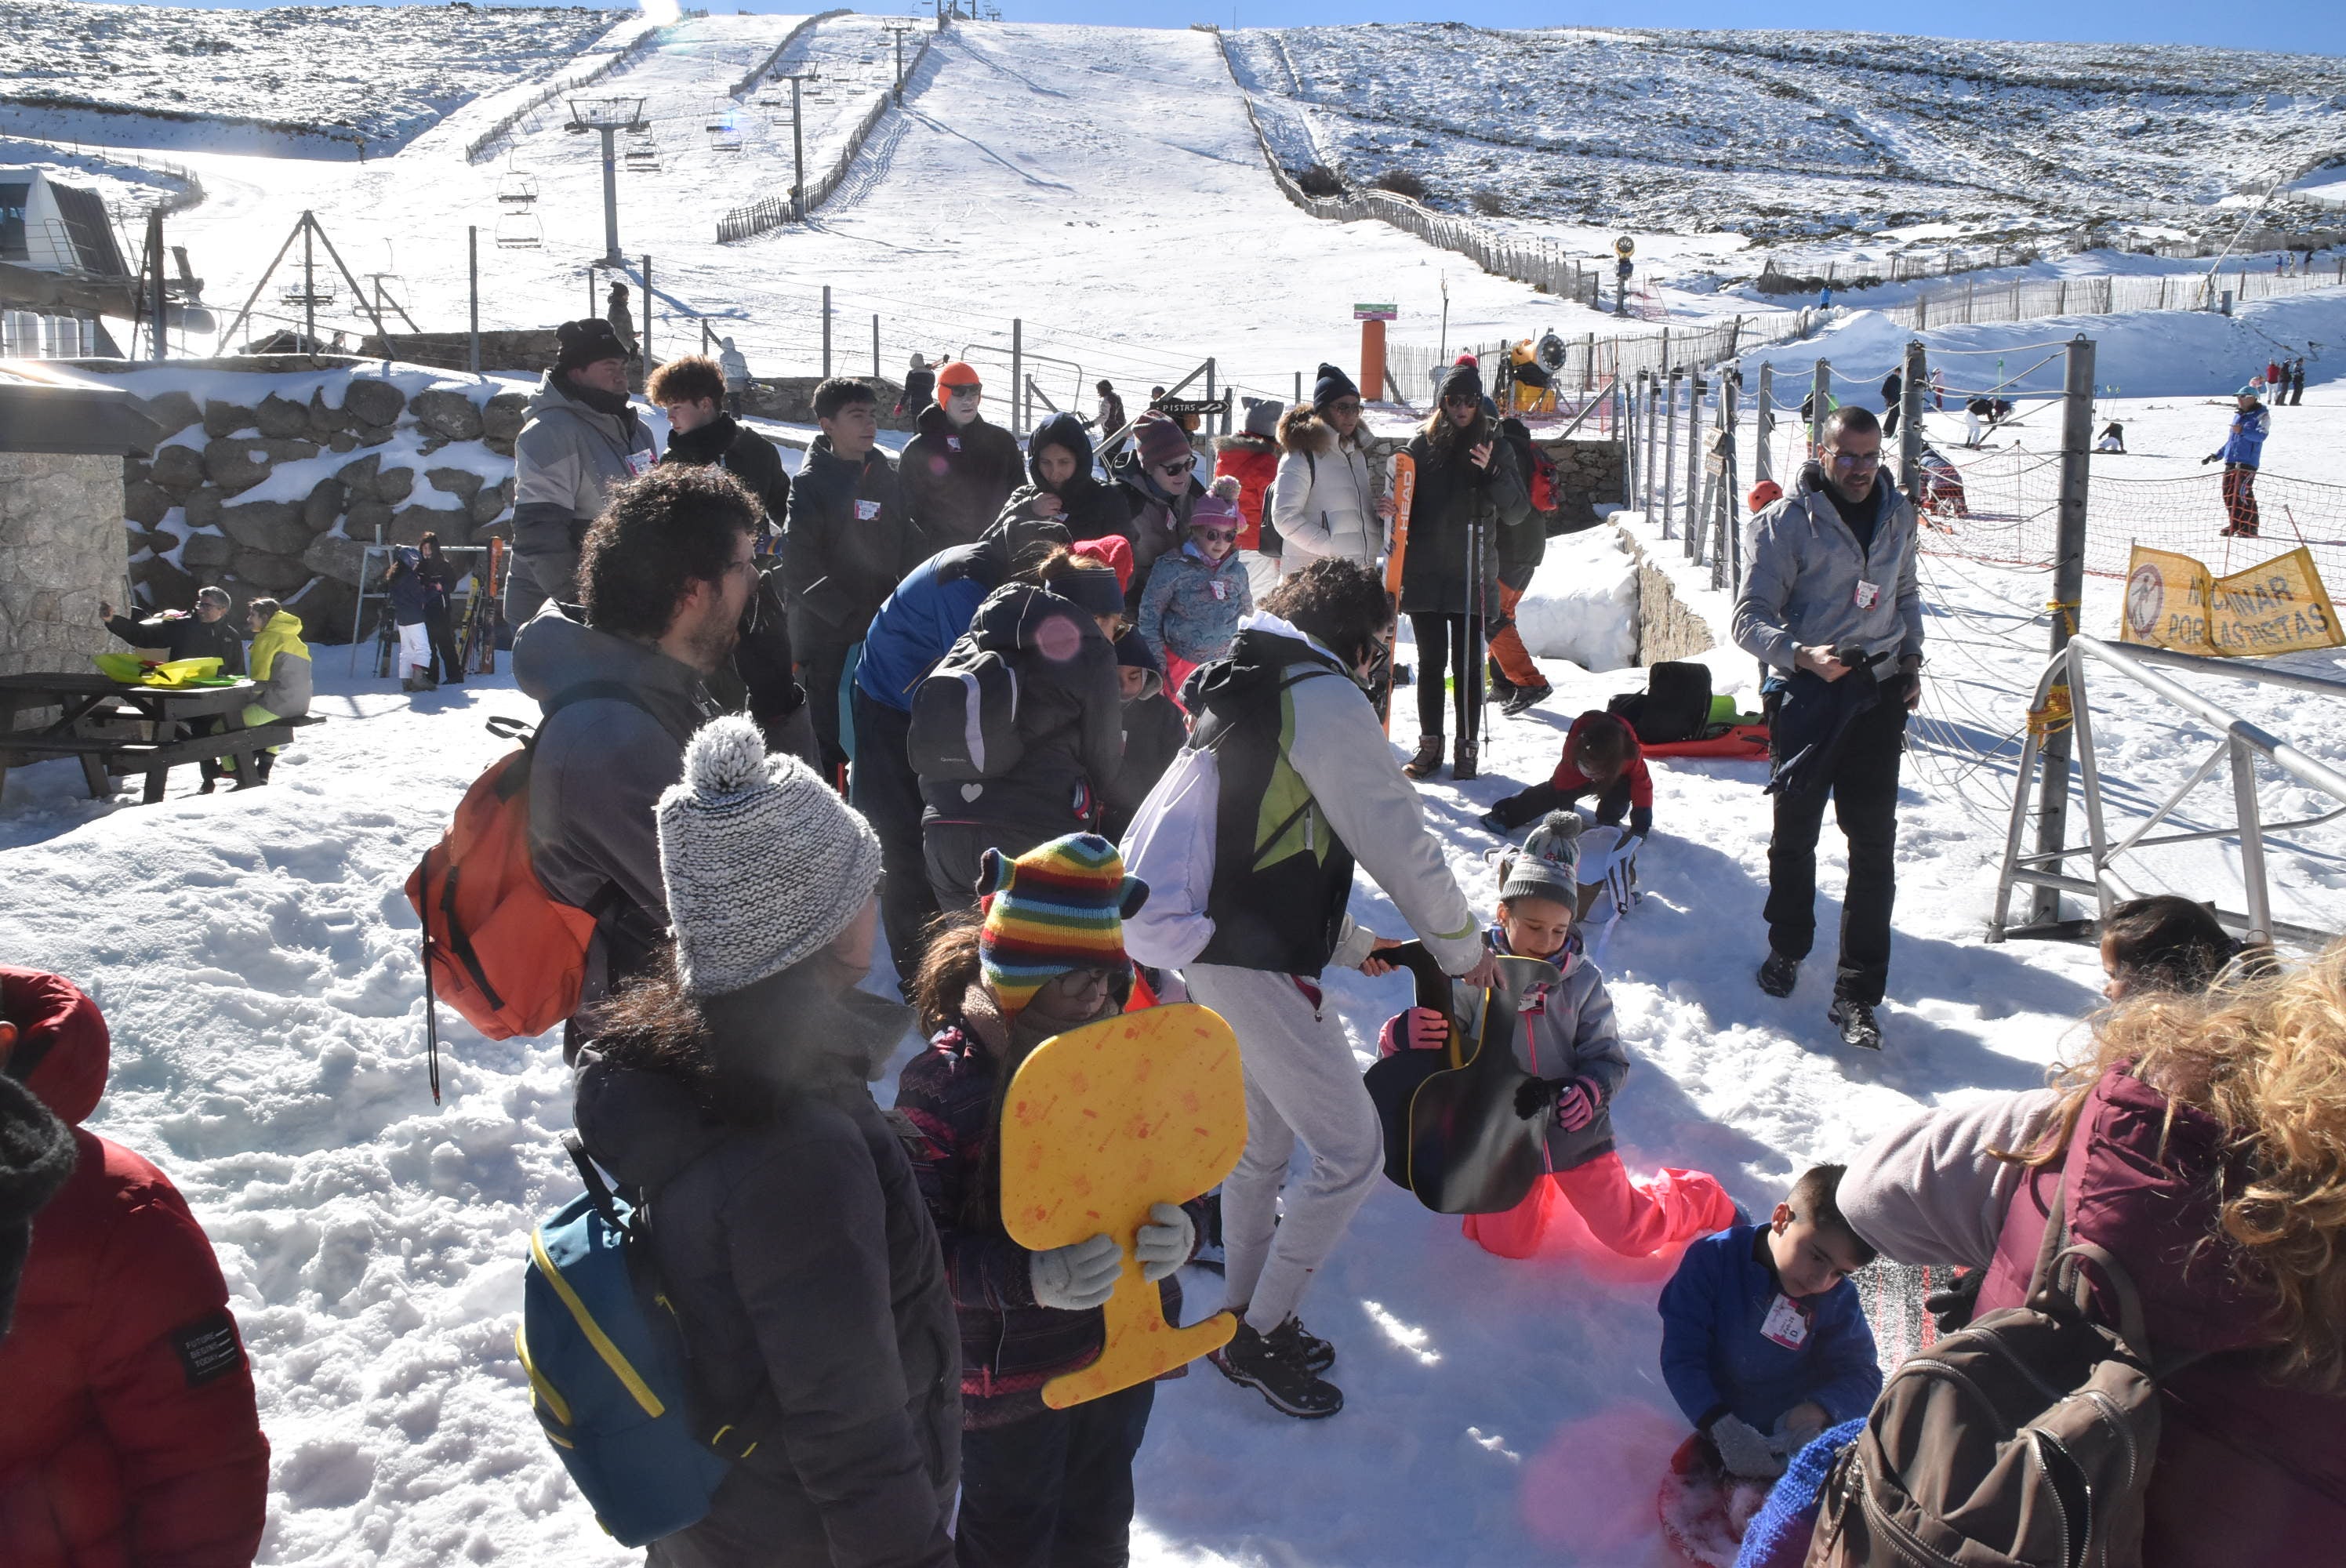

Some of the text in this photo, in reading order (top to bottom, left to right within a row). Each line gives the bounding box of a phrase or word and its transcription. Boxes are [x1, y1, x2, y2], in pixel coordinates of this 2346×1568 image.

[1400, 470, 1412, 531] HEAD
[2188, 575, 2206, 608] NO
[2169, 603, 2329, 648] POR LAS PISTAS
[185, 1332, 215, 1349] FUTURE
[190, 1341, 220, 1359] BEGINS
[194, 1355, 219, 1368] TODAY
